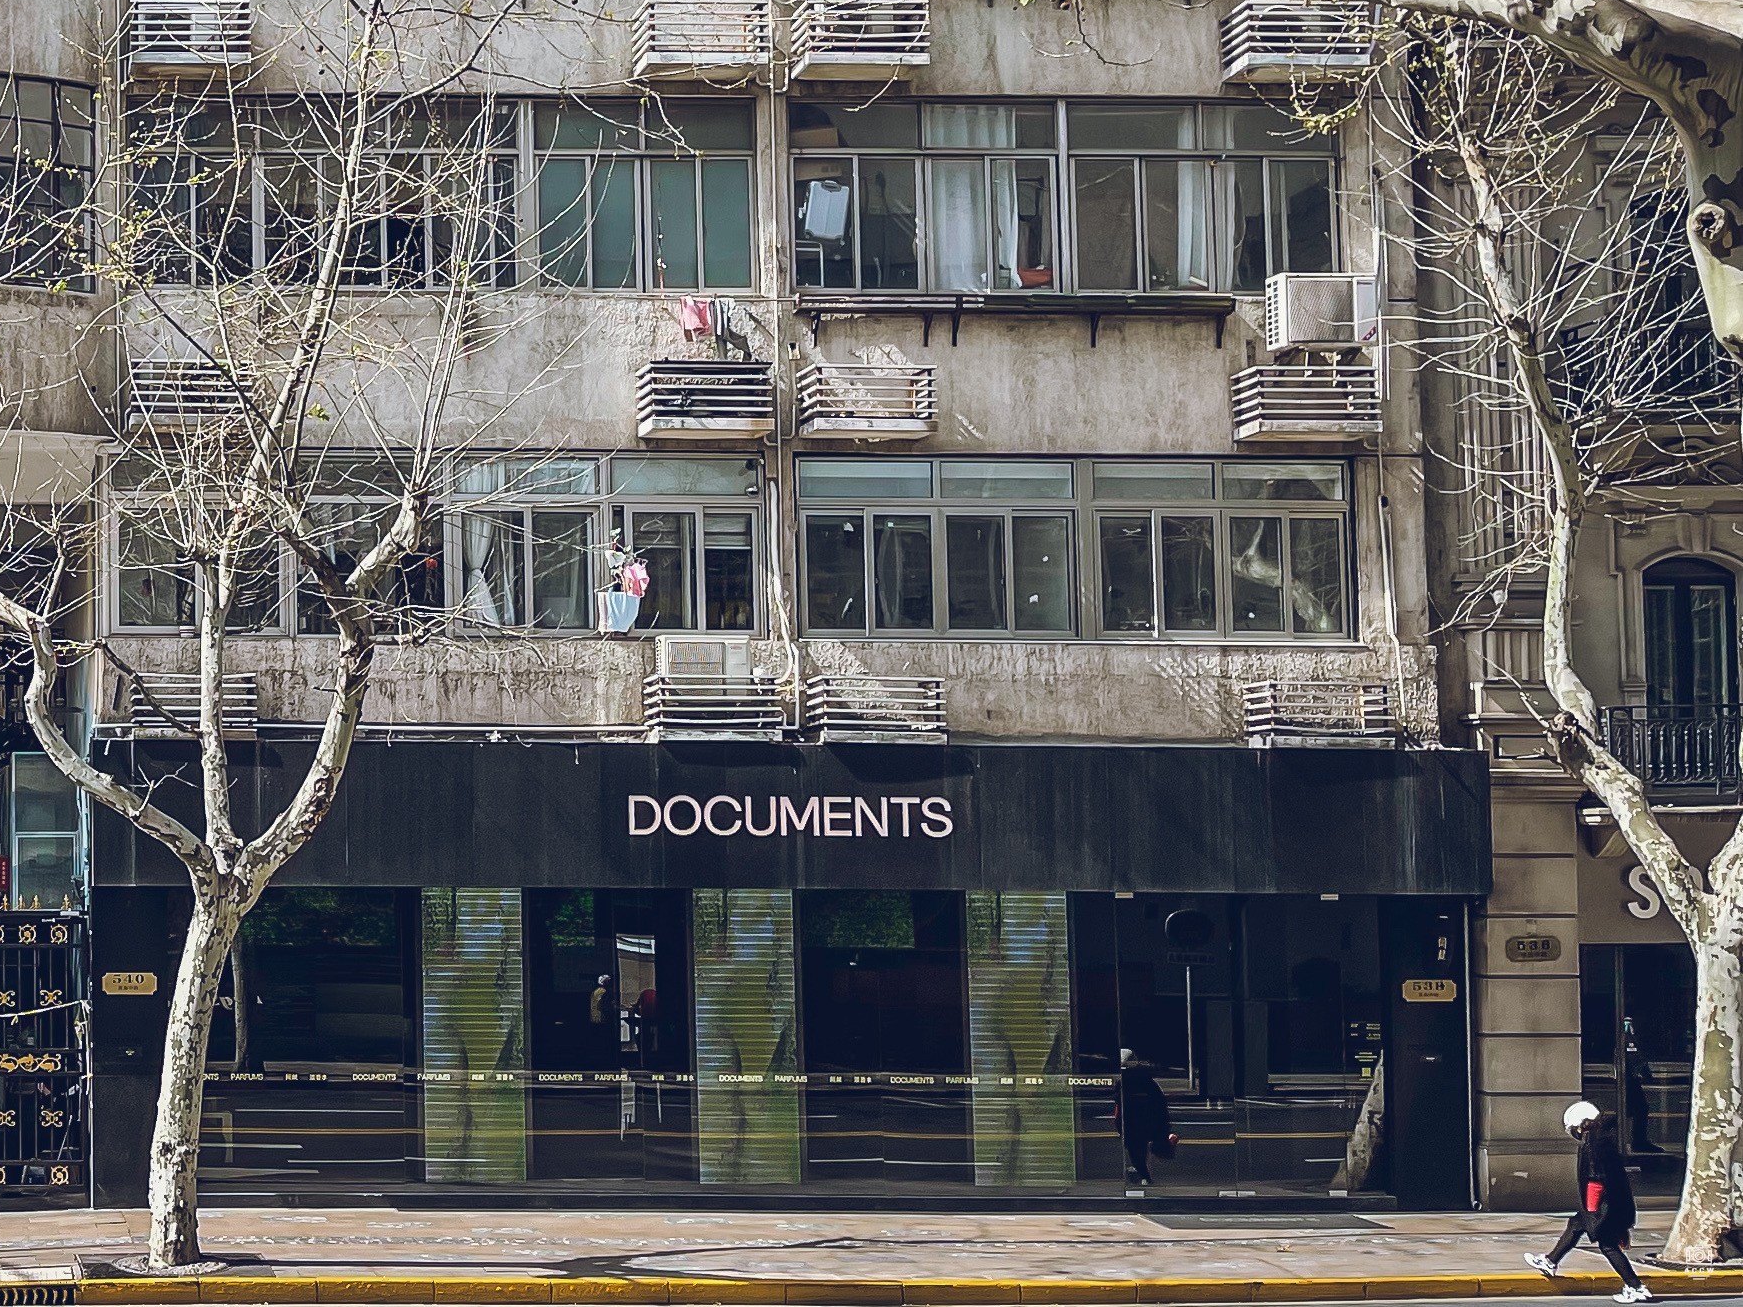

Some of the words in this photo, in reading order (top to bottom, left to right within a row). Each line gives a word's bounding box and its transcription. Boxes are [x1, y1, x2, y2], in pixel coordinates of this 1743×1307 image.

[627, 794, 954, 838] DOCUMENTS
[112, 974, 145, 984] 540
[230, 1073, 264, 1081] PARFUMS
[352, 1073, 397, 1081] DOCUMENTS
[538, 1073, 583, 1082] DOCUMENTS
[594, 1074, 628, 1082] PARFUMS
[718, 1074, 764, 1083] DOCUMENTS
[890, 1076, 935, 1084] DOCUMENTS
[1068, 1077, 1113, 1086] DOCUMENTS
